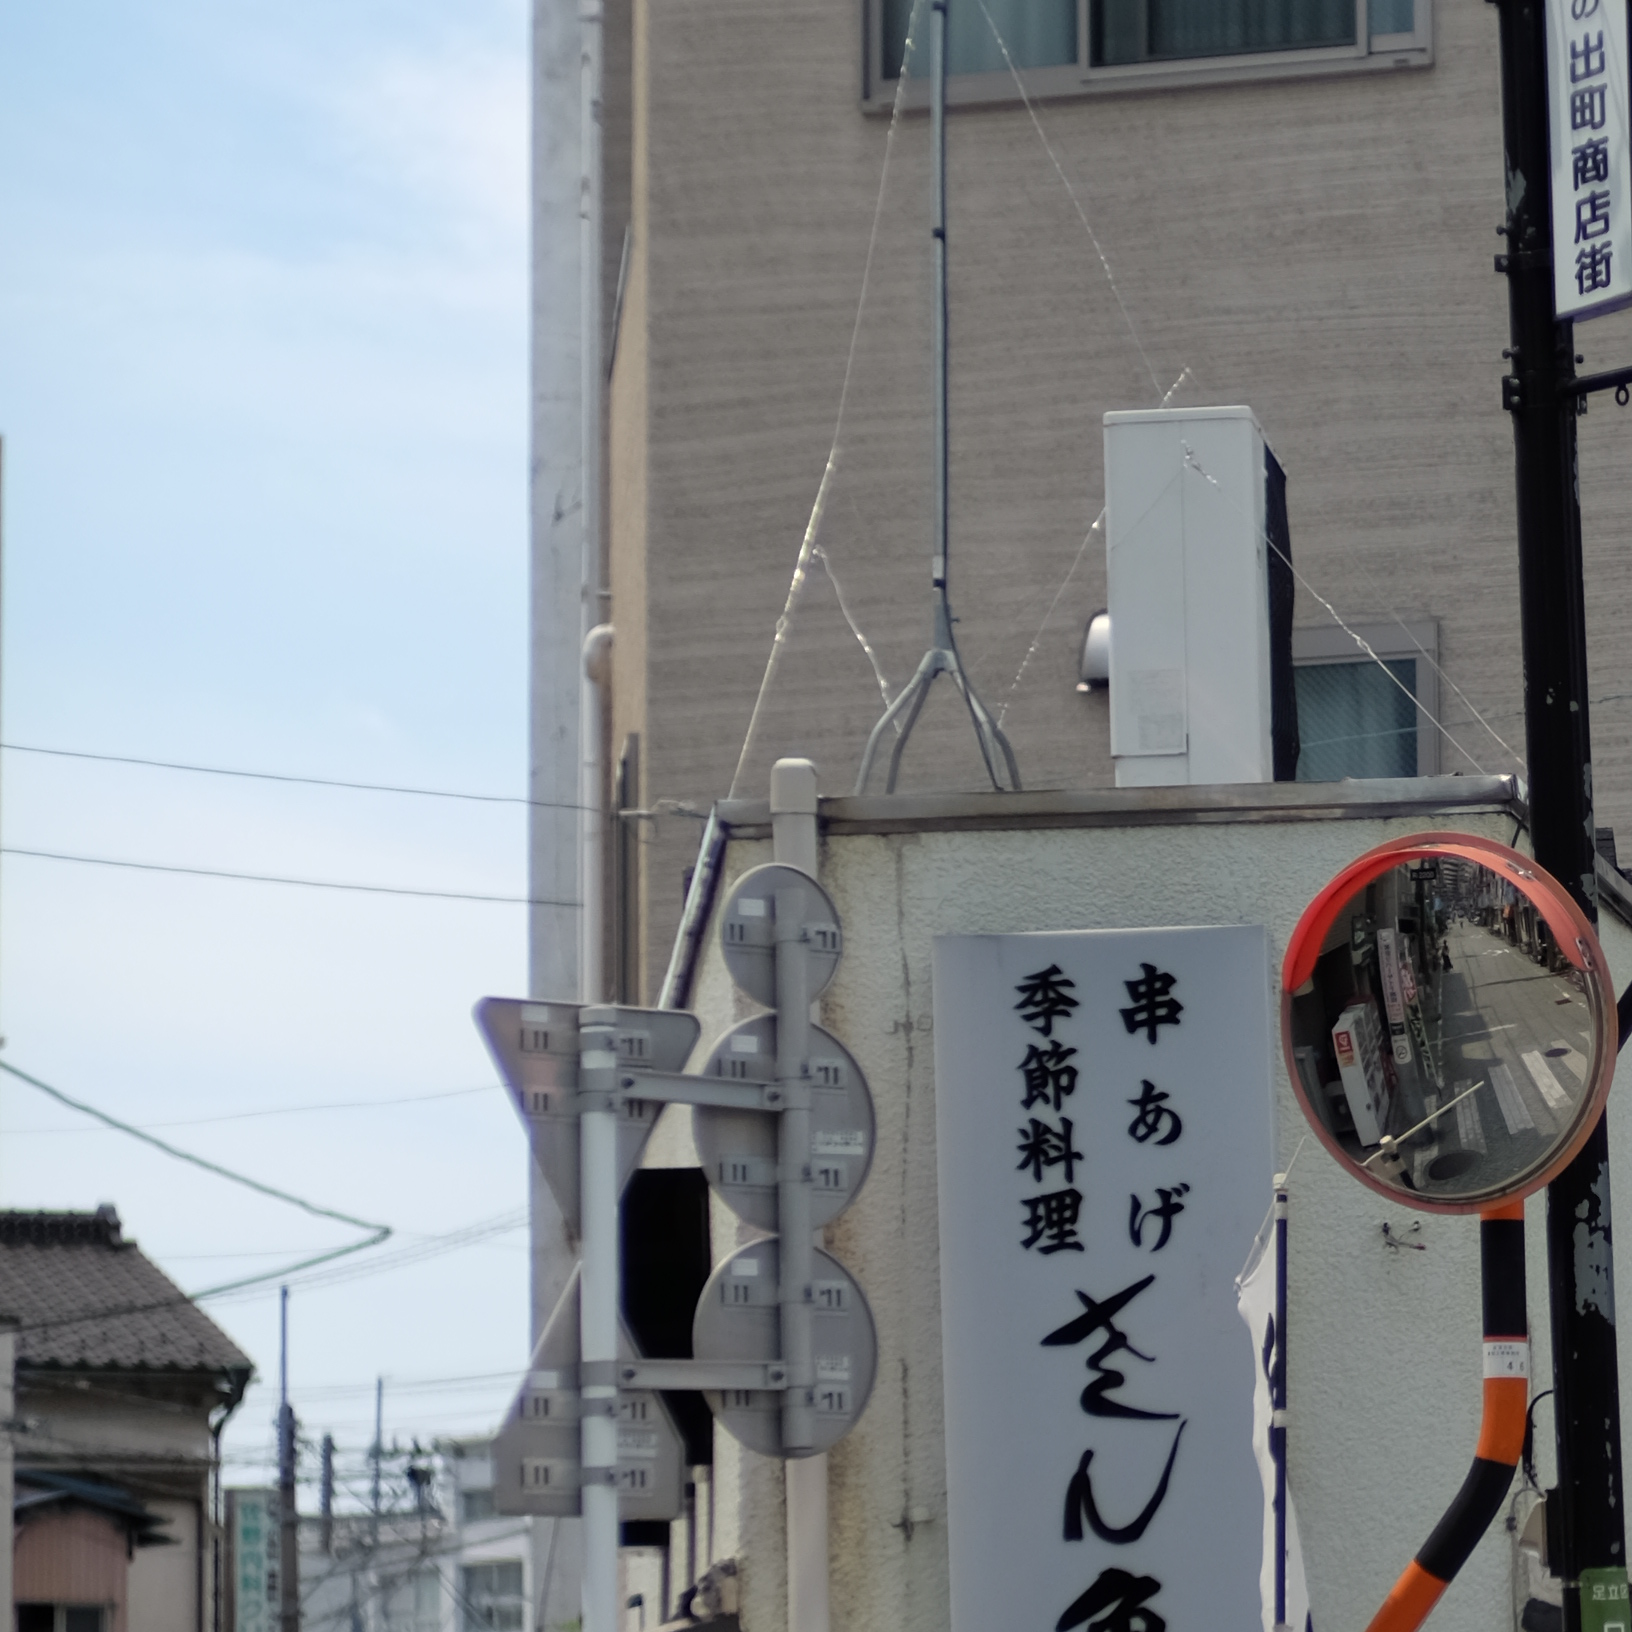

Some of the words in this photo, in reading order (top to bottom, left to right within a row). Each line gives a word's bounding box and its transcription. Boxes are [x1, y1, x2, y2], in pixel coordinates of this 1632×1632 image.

[1012, 963, 1087, 1257] 季節料理
[1118, 962, 1189, 1254] 串あげ
